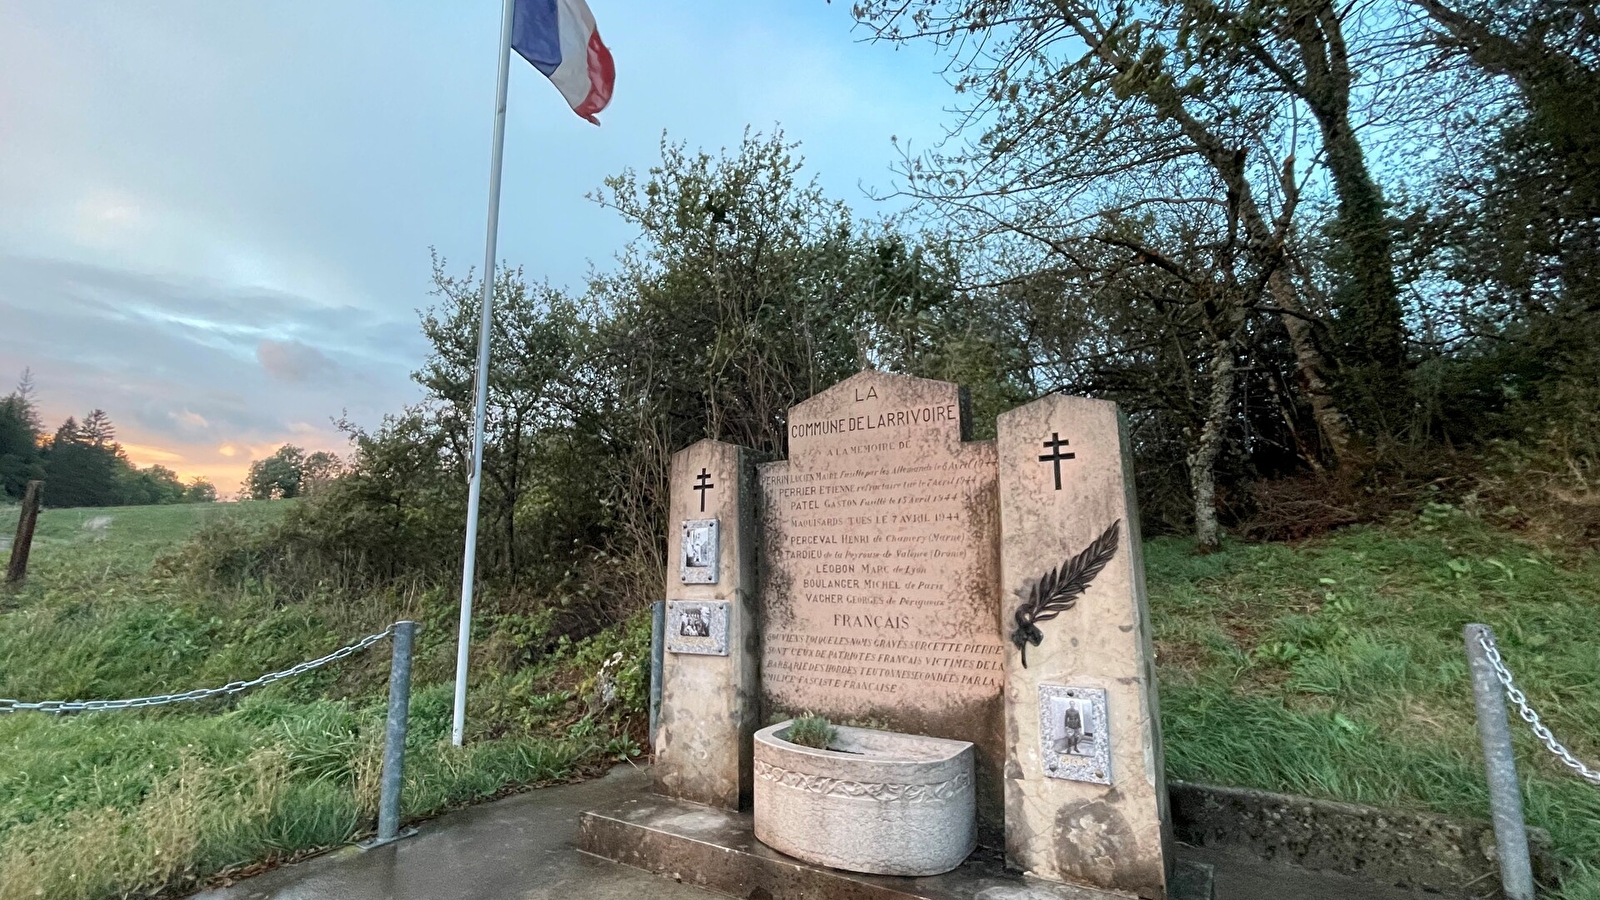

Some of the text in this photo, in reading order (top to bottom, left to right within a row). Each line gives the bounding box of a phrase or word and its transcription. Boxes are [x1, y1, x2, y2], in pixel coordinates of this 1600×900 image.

[855, 386, 878, 401] LA
[791, 404, 956, 438] COMMUNE DE LARRIVOIRE
[899, 441, 912, 449] DE
[762, 475, 789, 486] PERRIN
[790, 473, 814, 483] LUCIEN
[891, 464, 932, 475] Allemands
[780, 486, 816, 497] PERRIER
[820, 485, 855, 495] ETIENNE
[927, 478, 932, 486] 7
[932, 477, 954, 486] Avril
[956, 475, 977, 485] 1944
[791, 500, 819, 510] PATEL
[824, 499, 857, 509] GASTON
[909, 495, 931, 504] Avril
[933, 493, 958, 502] 1944
[791, 517, 843, 527] MAQUISARDS
[876, 515, 888, 524] LE
[892, 515, 898, 523] 7
[900, 514, 930, 523] AVRIL
[935, 513, 960, 522] 1944
[790, 535, 837, 545] PERCEVAL
[841, 534, 869, 544] HENRI
[929, 532, 965, 543] (Marne)
[785, 550, 822, 559] TARDIEU
[834, 551, 843, 559] la
[883, 550, 892, 558] de
[896, 549, 928, 558] Valence
[862, 564, 889, 574] MARC
[893, 565, 904, 573] de
[905, 565, 927, 575] Lyon
[803, 579, 859, 589] BOULANGER
[905, 581, 915, 589] de
[918, 581, 943, 589] Paris
[806, 593, 843, 603] VACHER
[886, 596, 896, 604] de
[767, 633, 804, 643] SOUVIENS
[851, 637, 872, 647] NOMS
[963, 643, 1004, 655] PIERRE
[767, 647, 788, 656] SONT
[791, 648, 813, 657] CEUX
[815, 649, 828, 658] DE
[828, 650, 876, 662] PATRIOTES
[925, 656, 974, 668] VICTIMES
[976, 660, 991, 670] DE
[992, 661, 1004, 671] LA
[767, 660, 808, 672] BARBARIE
[825, 664, 857, 675] HORDES
[961, 675, 980, 685] PAR
[982, 676, 995, 686] LA
[767, 673, 795, 684] MILICE
[798, 675, 841, 688] FASCISTE
